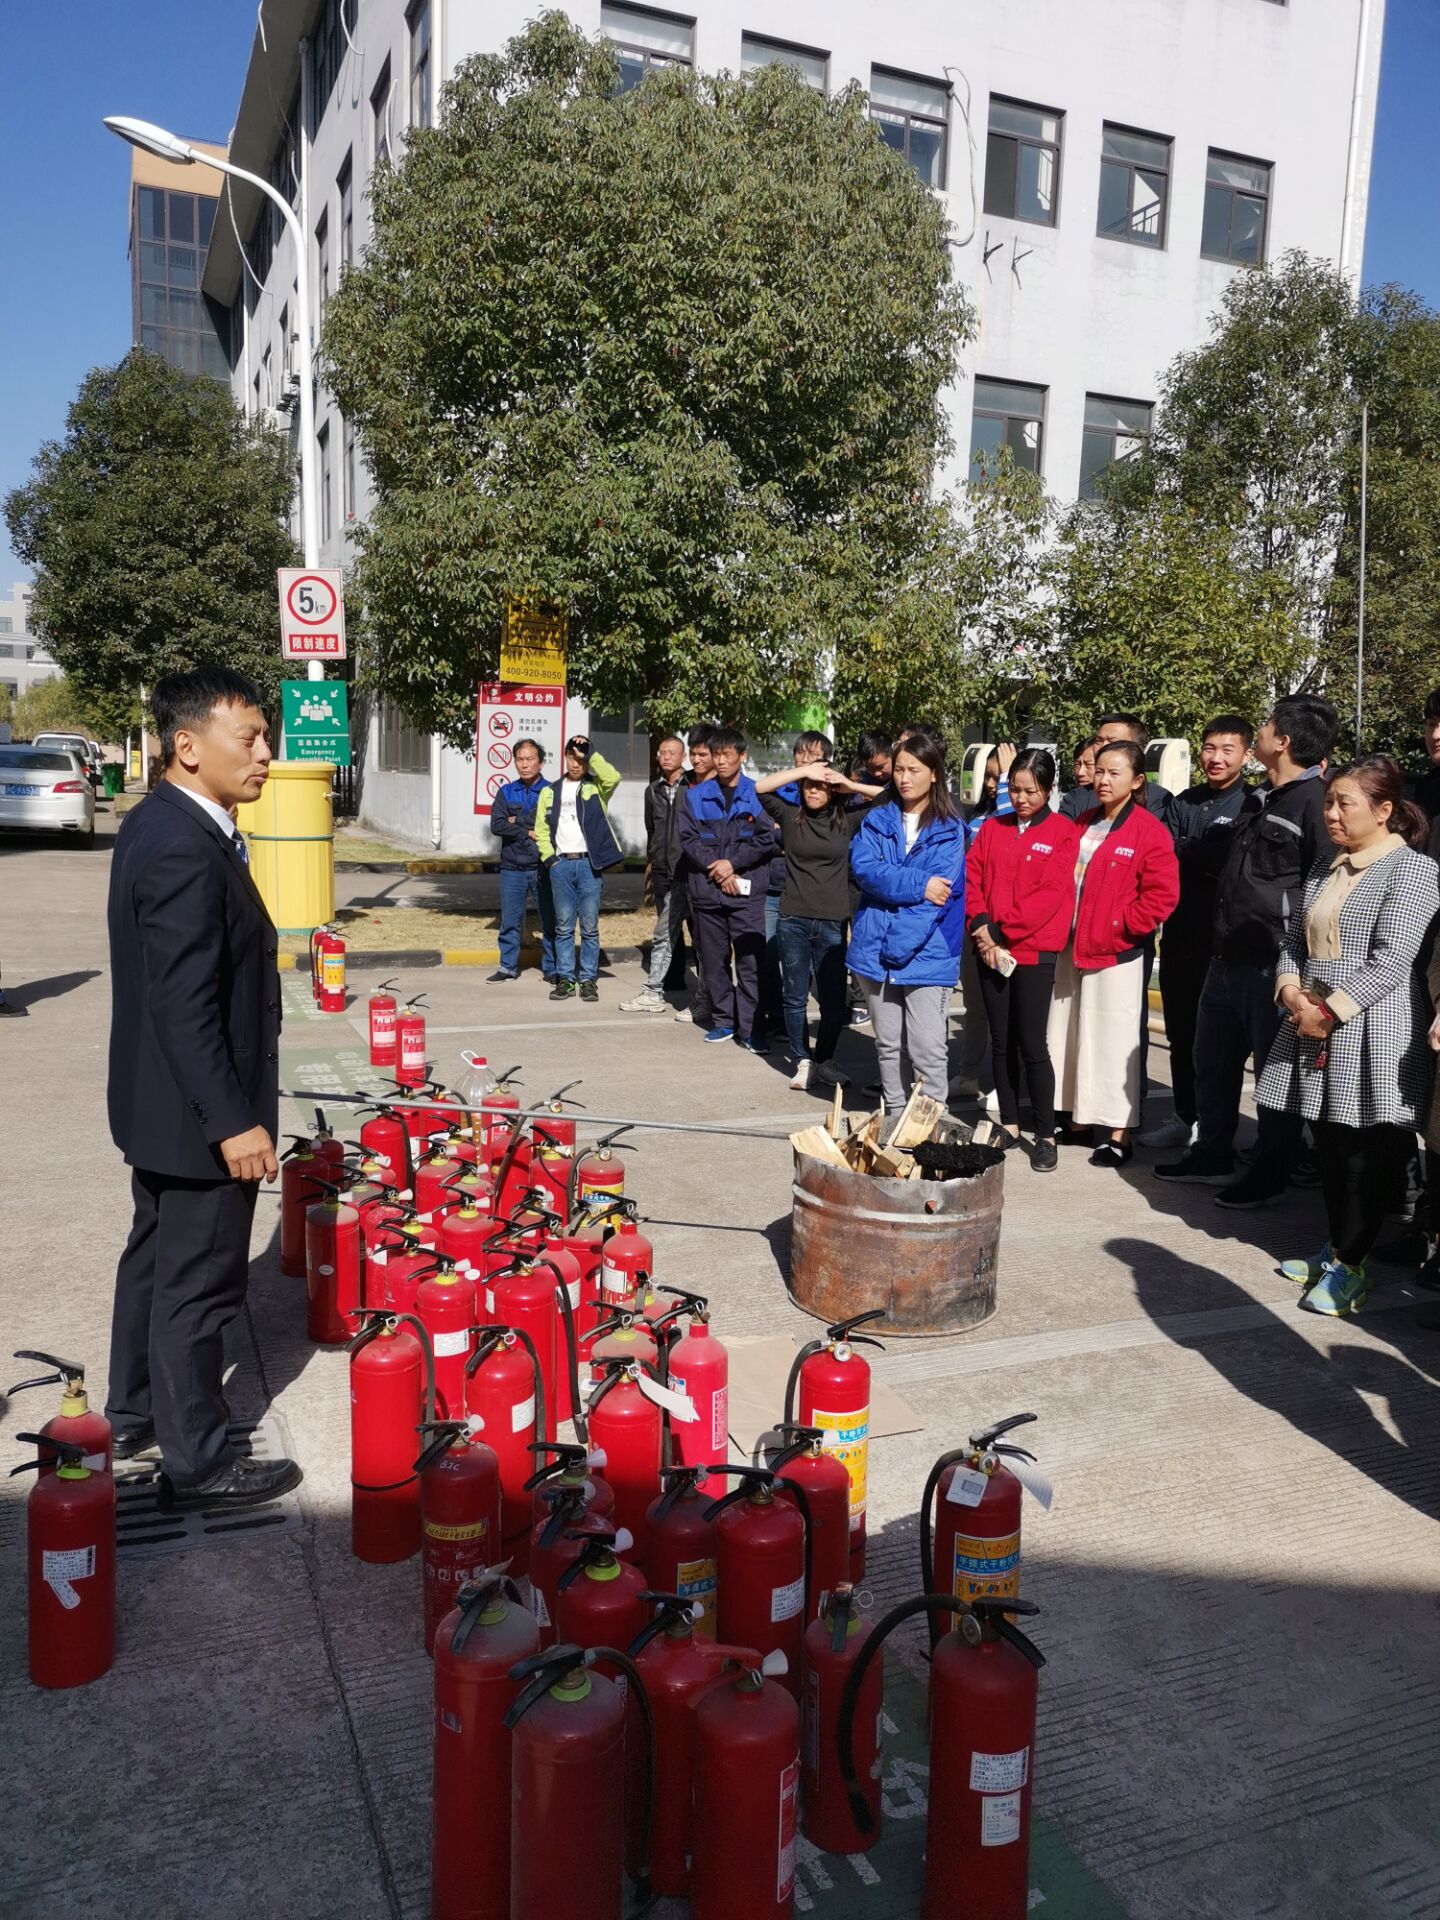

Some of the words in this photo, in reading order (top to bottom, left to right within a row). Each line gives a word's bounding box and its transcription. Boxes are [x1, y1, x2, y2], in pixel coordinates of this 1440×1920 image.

[292, 636, 336, 650] 限制速度
[506, 667, 562, 679] 400-920-8050
[514, 692, 554, 703] 文明公约
